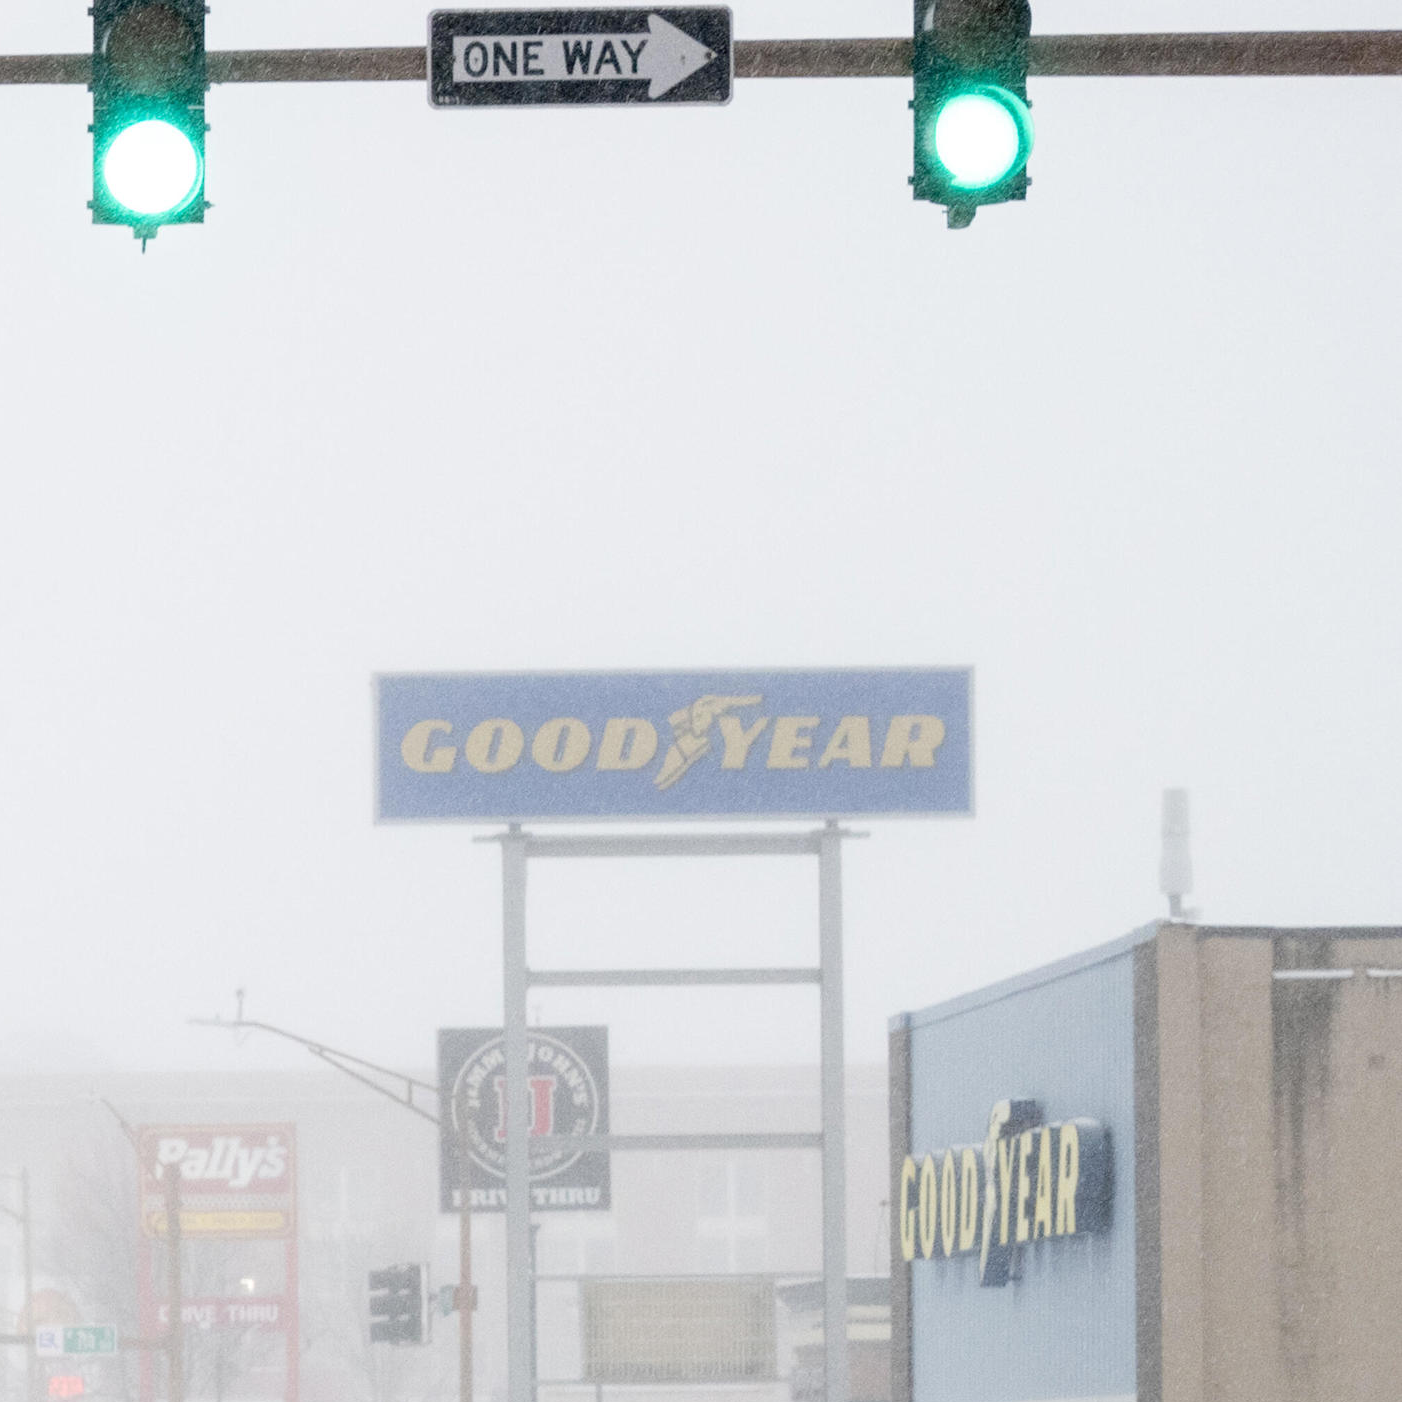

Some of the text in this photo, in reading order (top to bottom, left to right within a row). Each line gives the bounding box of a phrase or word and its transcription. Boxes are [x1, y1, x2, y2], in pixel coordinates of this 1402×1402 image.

[462, 38, 648, 79] ONE WAY
[400, 714, 946, 774] GOODYEAR
[466, 1043, 588, 1108] JIMM JOHN'S
[154, 1136, 286, 1188] Rally's
[532, 1187, 602, 1205] THRU
[901, 1123, 1080, 1261] GOODYEAR
[227, 1303, 279, 1323] THRU
